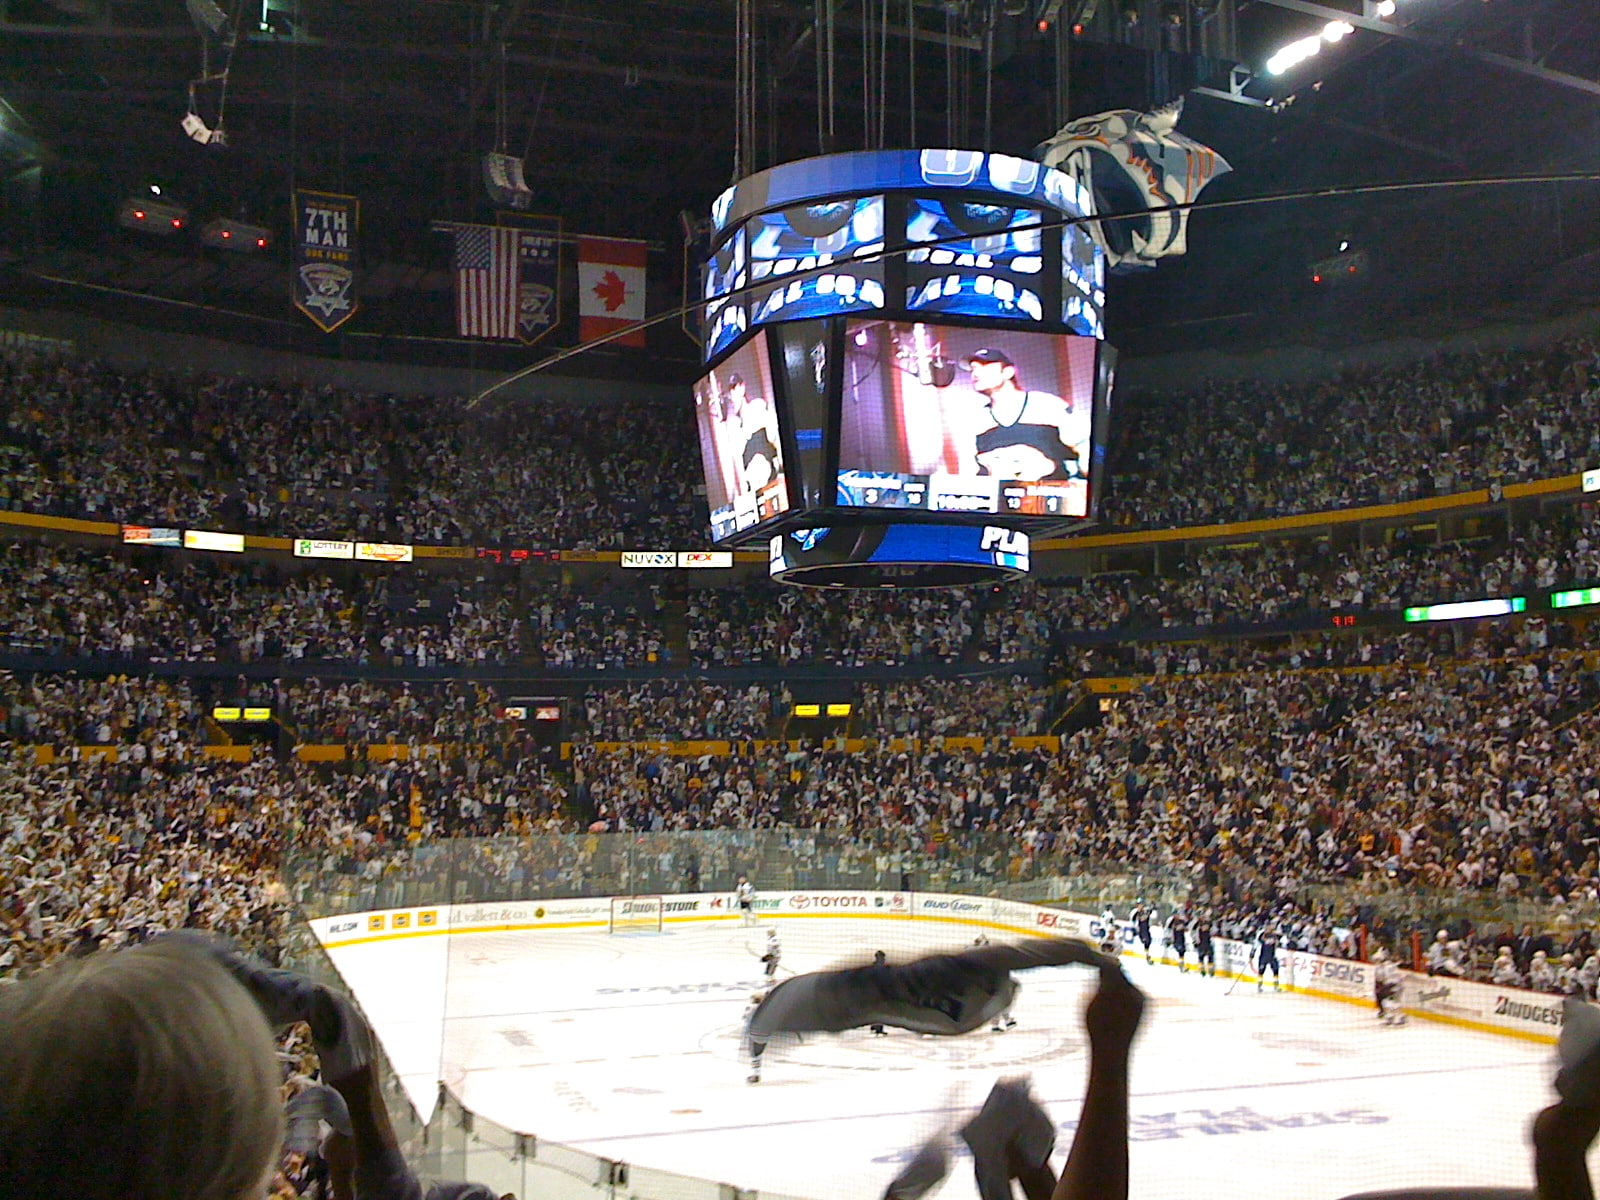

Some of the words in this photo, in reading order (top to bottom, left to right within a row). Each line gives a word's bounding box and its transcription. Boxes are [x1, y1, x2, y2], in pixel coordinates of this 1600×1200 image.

[305, 207, 348, 231] 7TH
[305, 228, 348, 248] MAN
[623, 554, 674, 564] NUVOX
[687, 553, 712, 561] DEX
[812, 896, 868, 907] TOYOTA
[923, 899, 949, 910] BUD
[952, 900, 983, 912] LIGHT
[1037, 911, 1059, 928] DEX
[1494, 995, 1566, 1026] BRIDGEST
